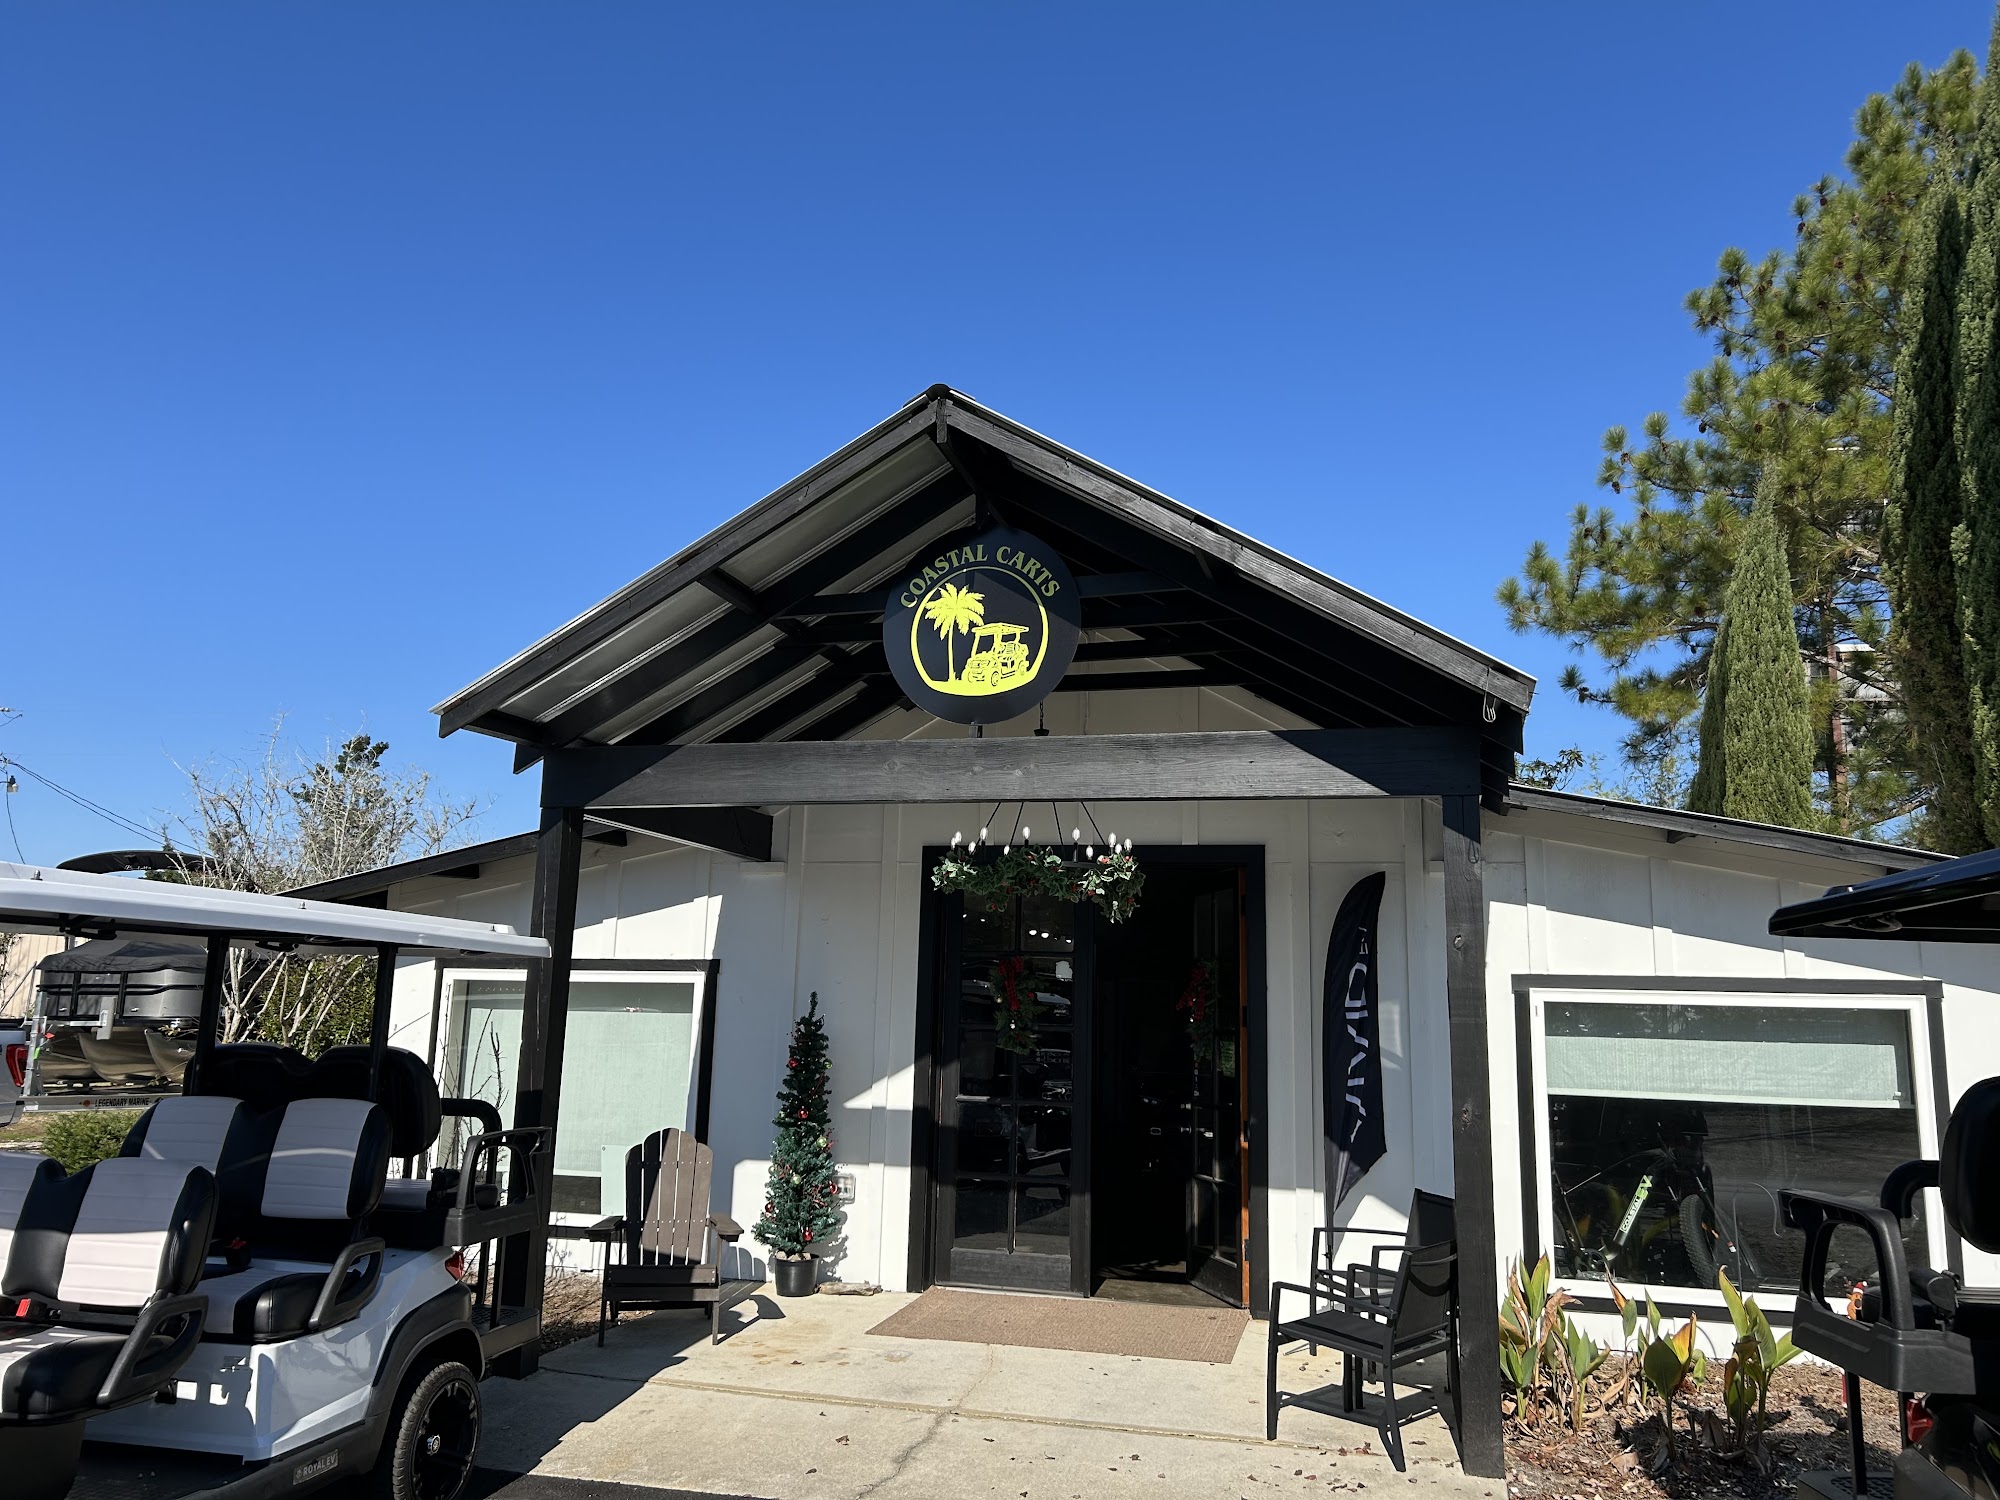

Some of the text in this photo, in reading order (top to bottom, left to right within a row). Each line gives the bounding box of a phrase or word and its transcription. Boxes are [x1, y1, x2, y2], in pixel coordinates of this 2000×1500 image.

[900, 544, 1061, 608] COASTAL CARTS
[1345, 962, 1368, 1143] VIVID
[94, 1097, 150, 1107] LEGENDARY MARINE
[1620, 1196, 1641, 1231] COASTAL
[302, 1453, 336, 1477] ROYAL EV
